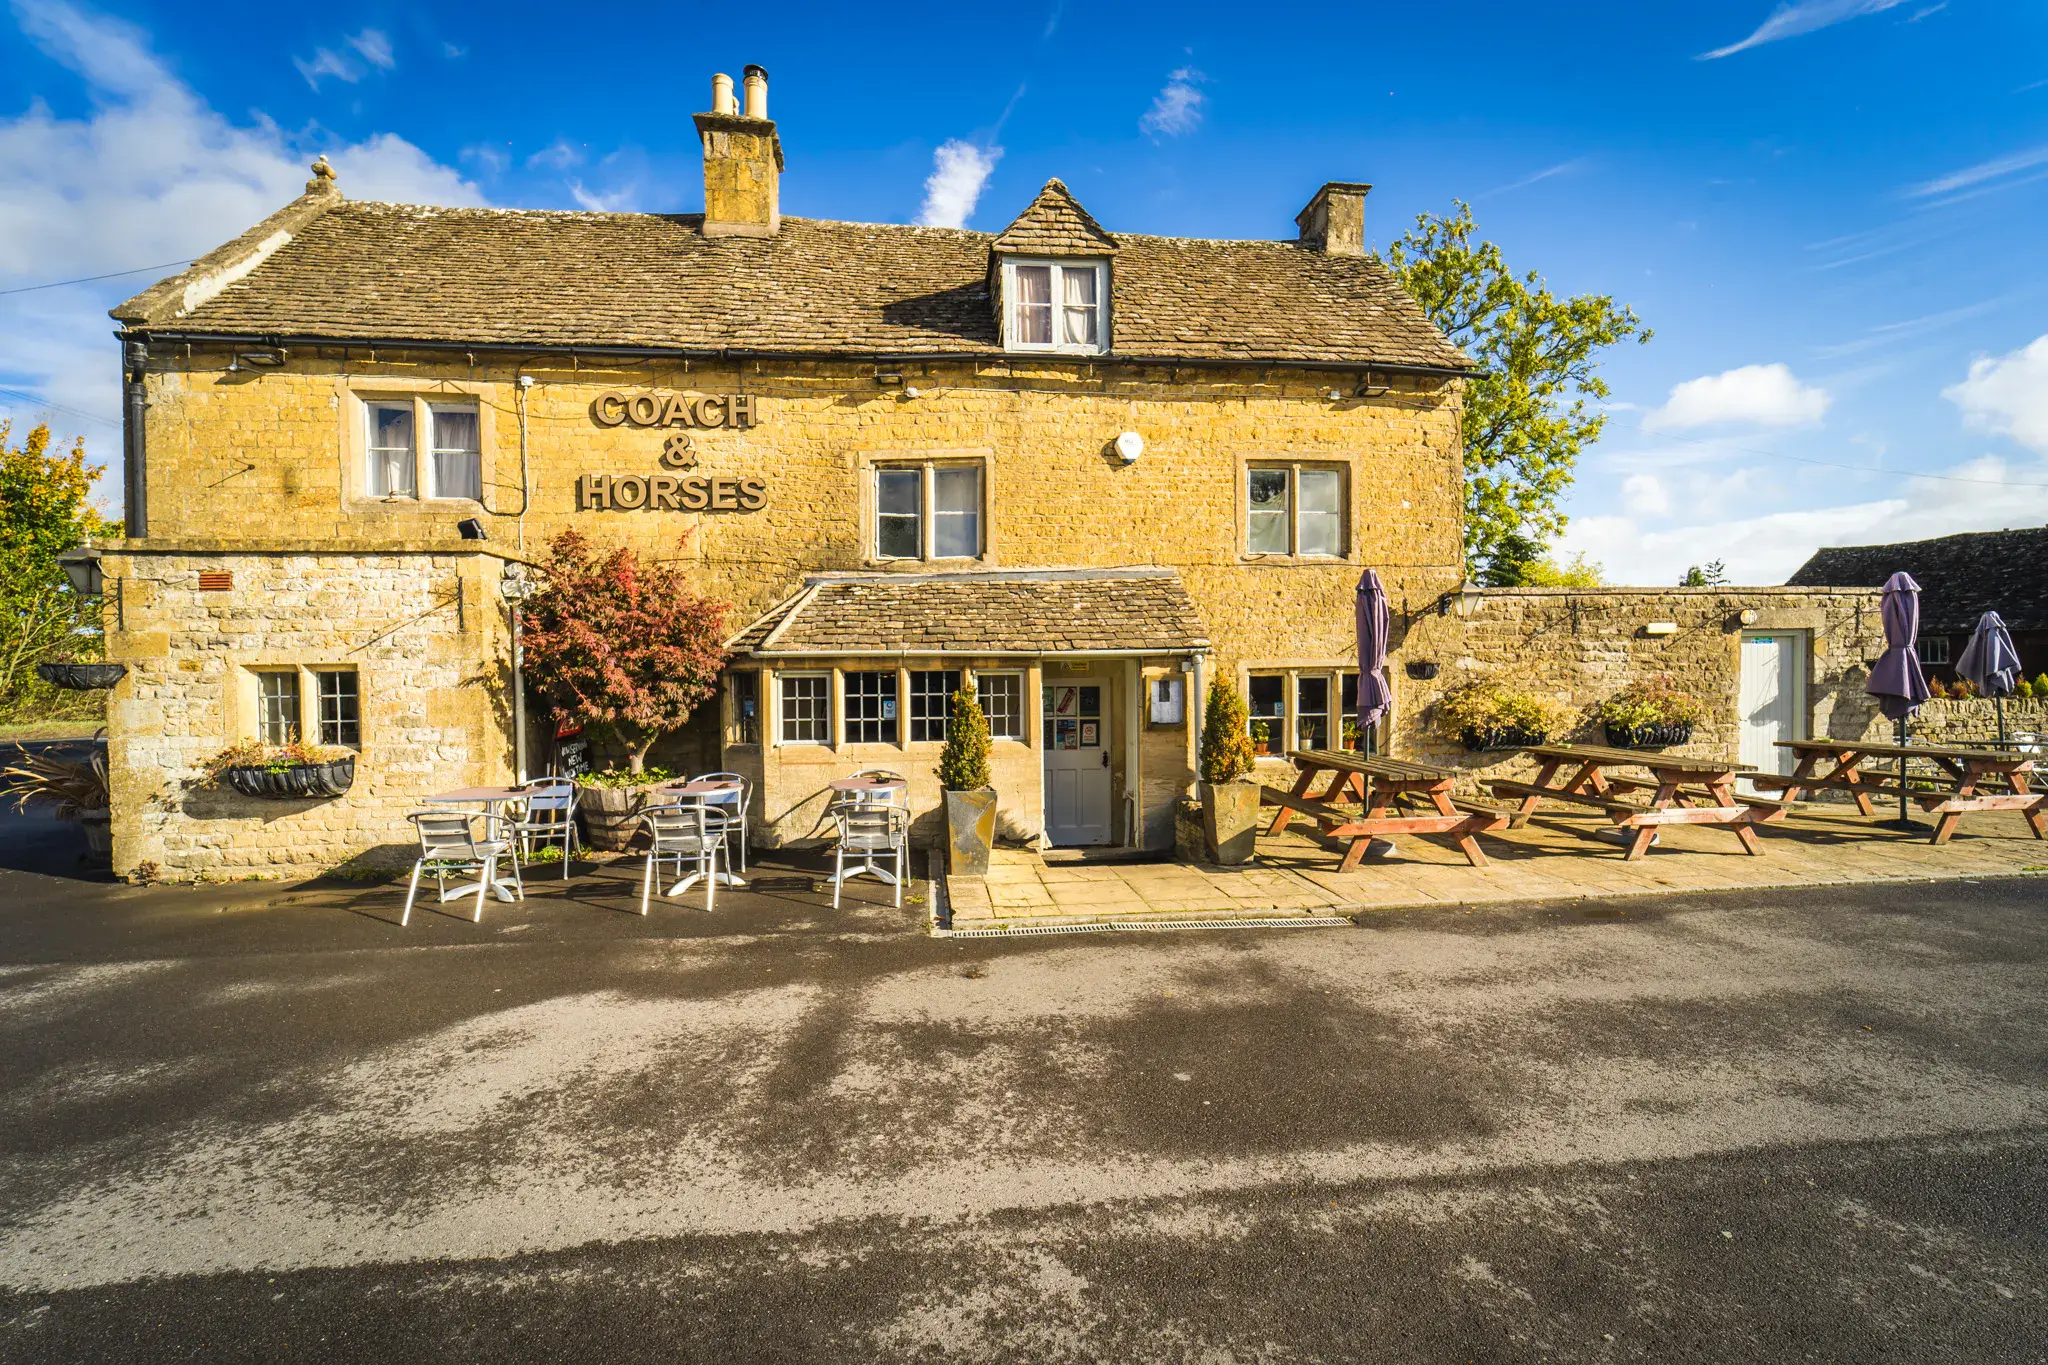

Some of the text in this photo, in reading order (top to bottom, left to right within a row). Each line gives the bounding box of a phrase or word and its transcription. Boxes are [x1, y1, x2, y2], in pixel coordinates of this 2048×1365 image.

[595, 391, 757, 428] COACH
[665, 432, 698, 468] &
[581, 474, 768, 510] HORSES
[568, 752, 582, 766] NEW
